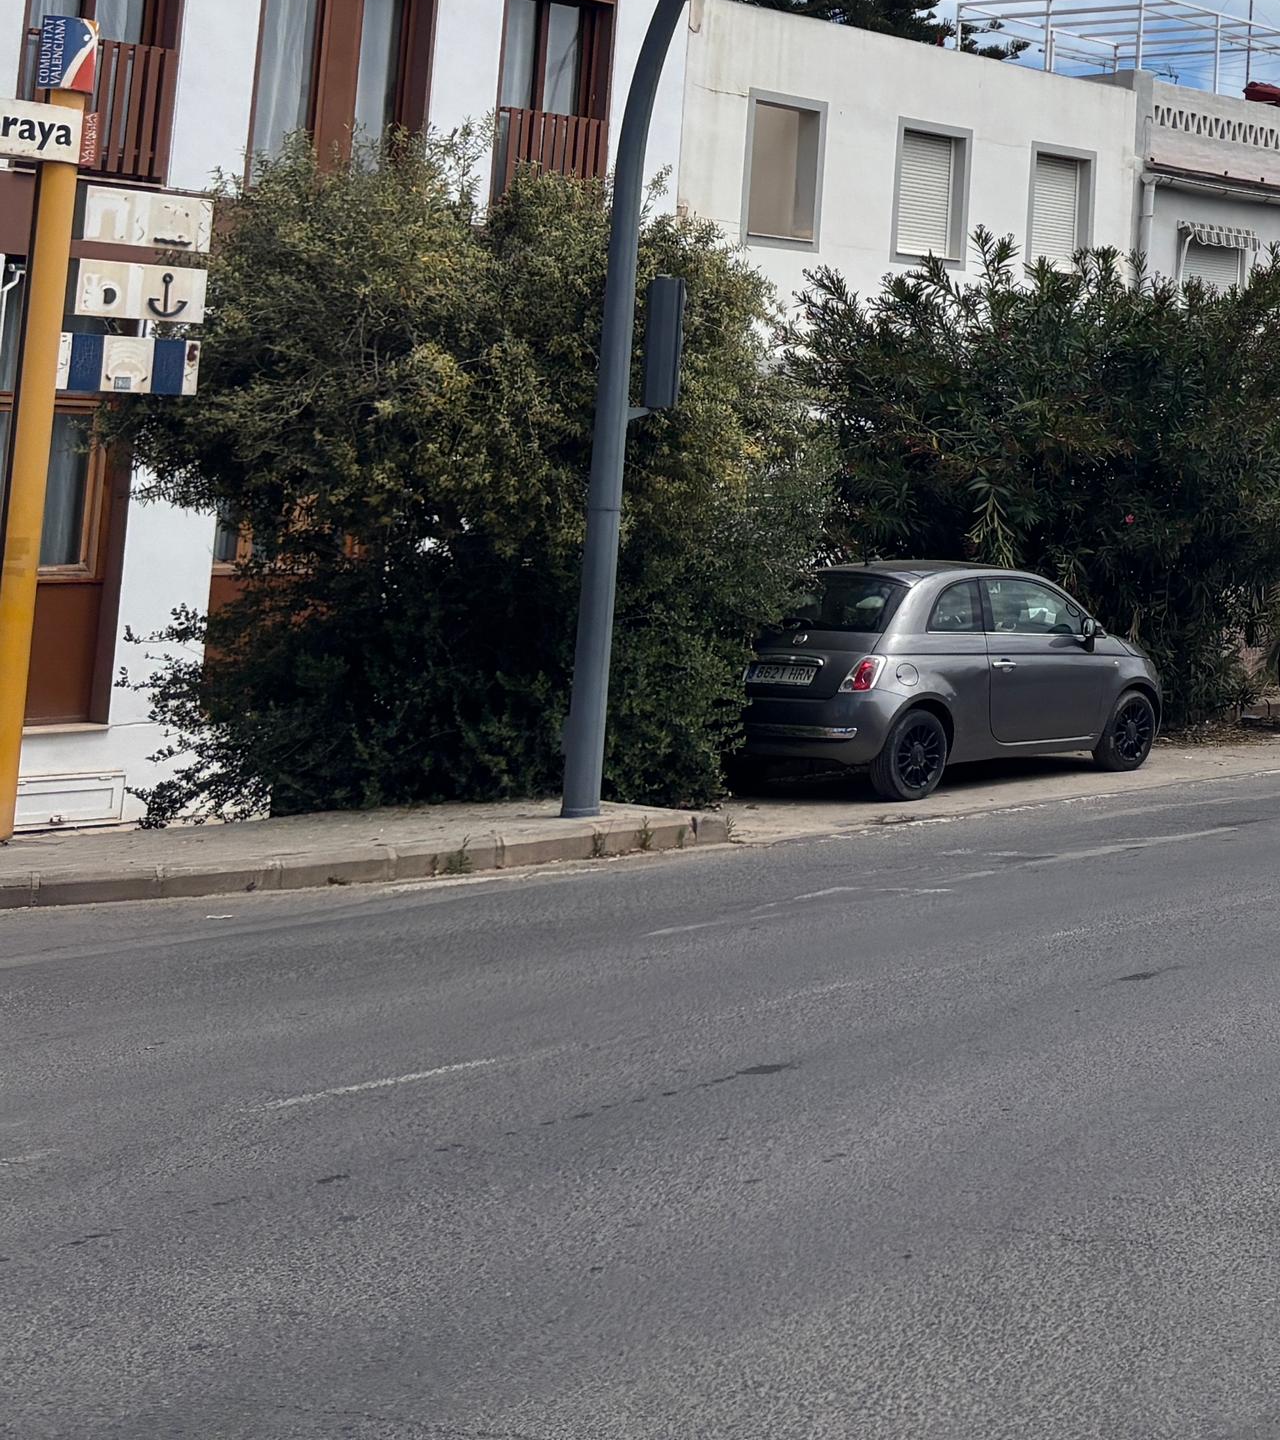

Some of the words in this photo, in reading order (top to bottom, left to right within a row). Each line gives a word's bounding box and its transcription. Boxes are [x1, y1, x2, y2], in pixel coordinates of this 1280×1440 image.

[38, 18, 55, 84] COMUNITAT
[50, 19, 66, 84] VALENCIANA
[0, 115, 72, 150] raya
